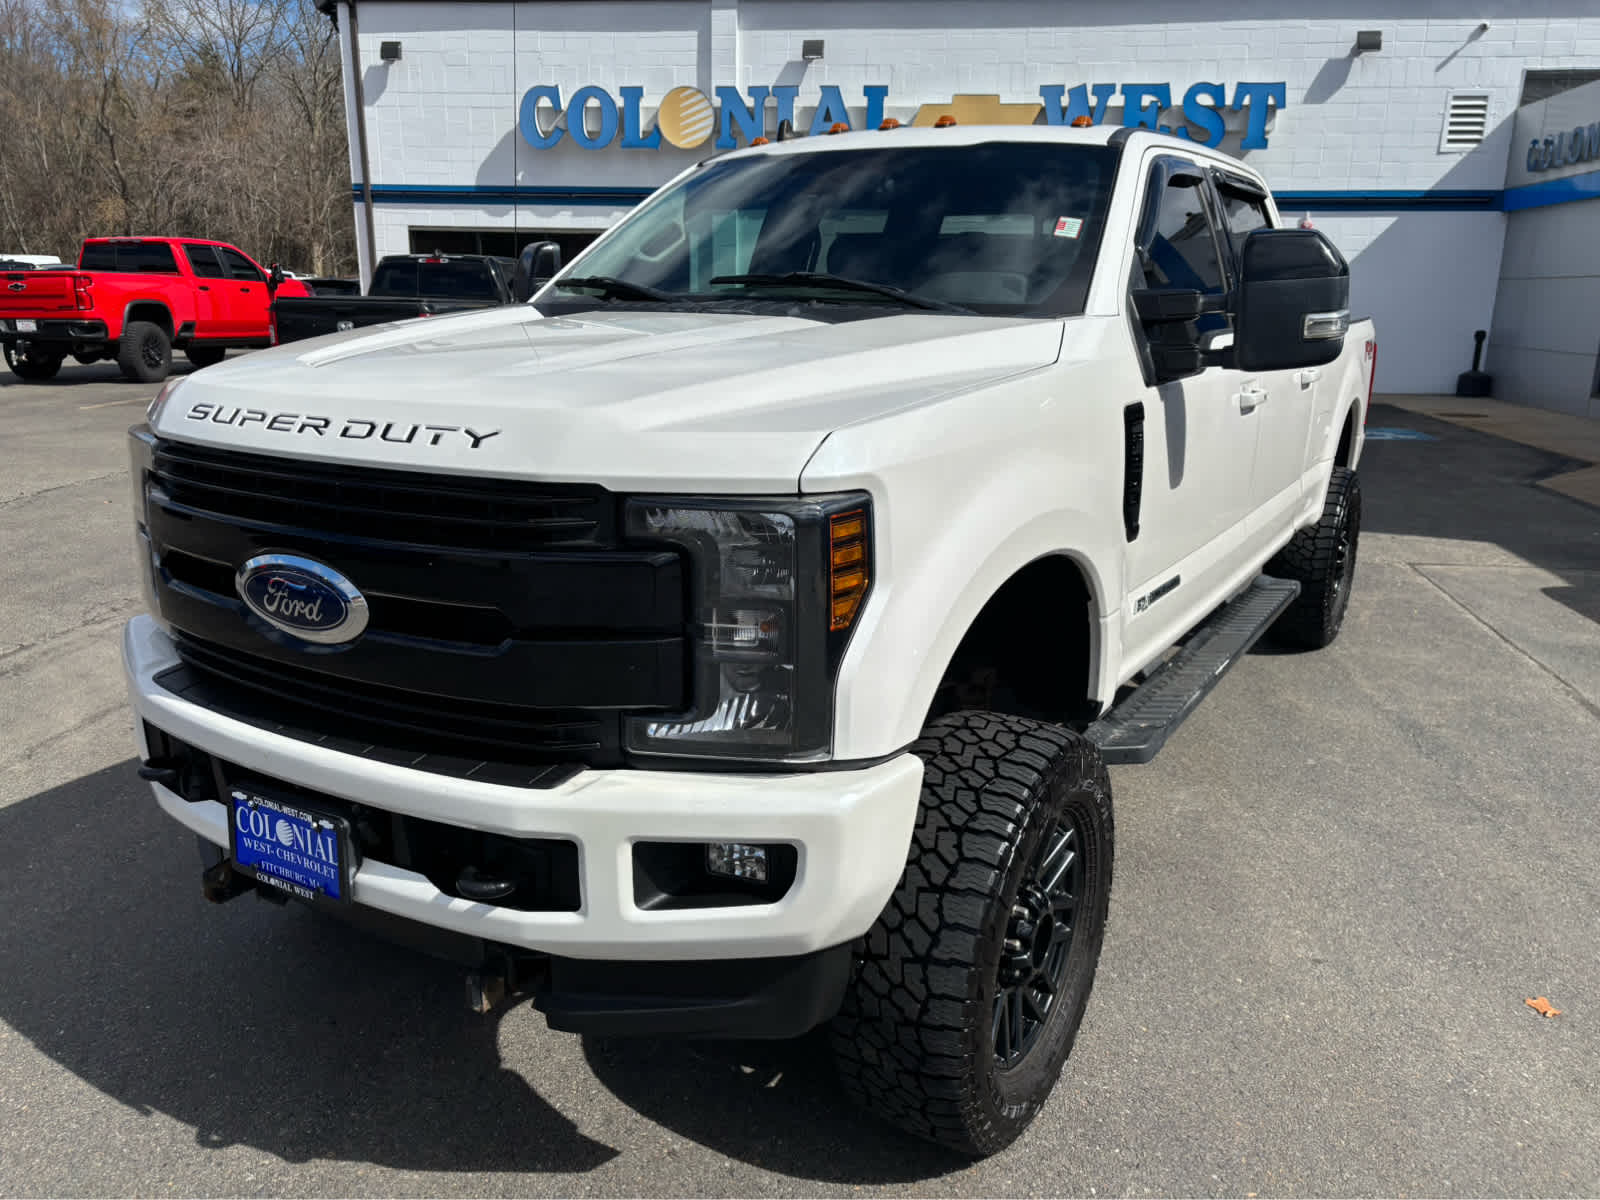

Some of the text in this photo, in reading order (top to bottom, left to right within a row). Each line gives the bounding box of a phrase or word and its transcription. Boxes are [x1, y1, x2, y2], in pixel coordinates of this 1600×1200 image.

[519, 82, 1287, 150] COLONIAL WEST
[186, 402, 501, 449] SUPER DUTY
[263, 577, 323, 622] Ford
[235, 805, 339, 867] COLONIAL
[276, 847, 337, 880] CHEVROLET
[293, 885, 315, 901] WEST
